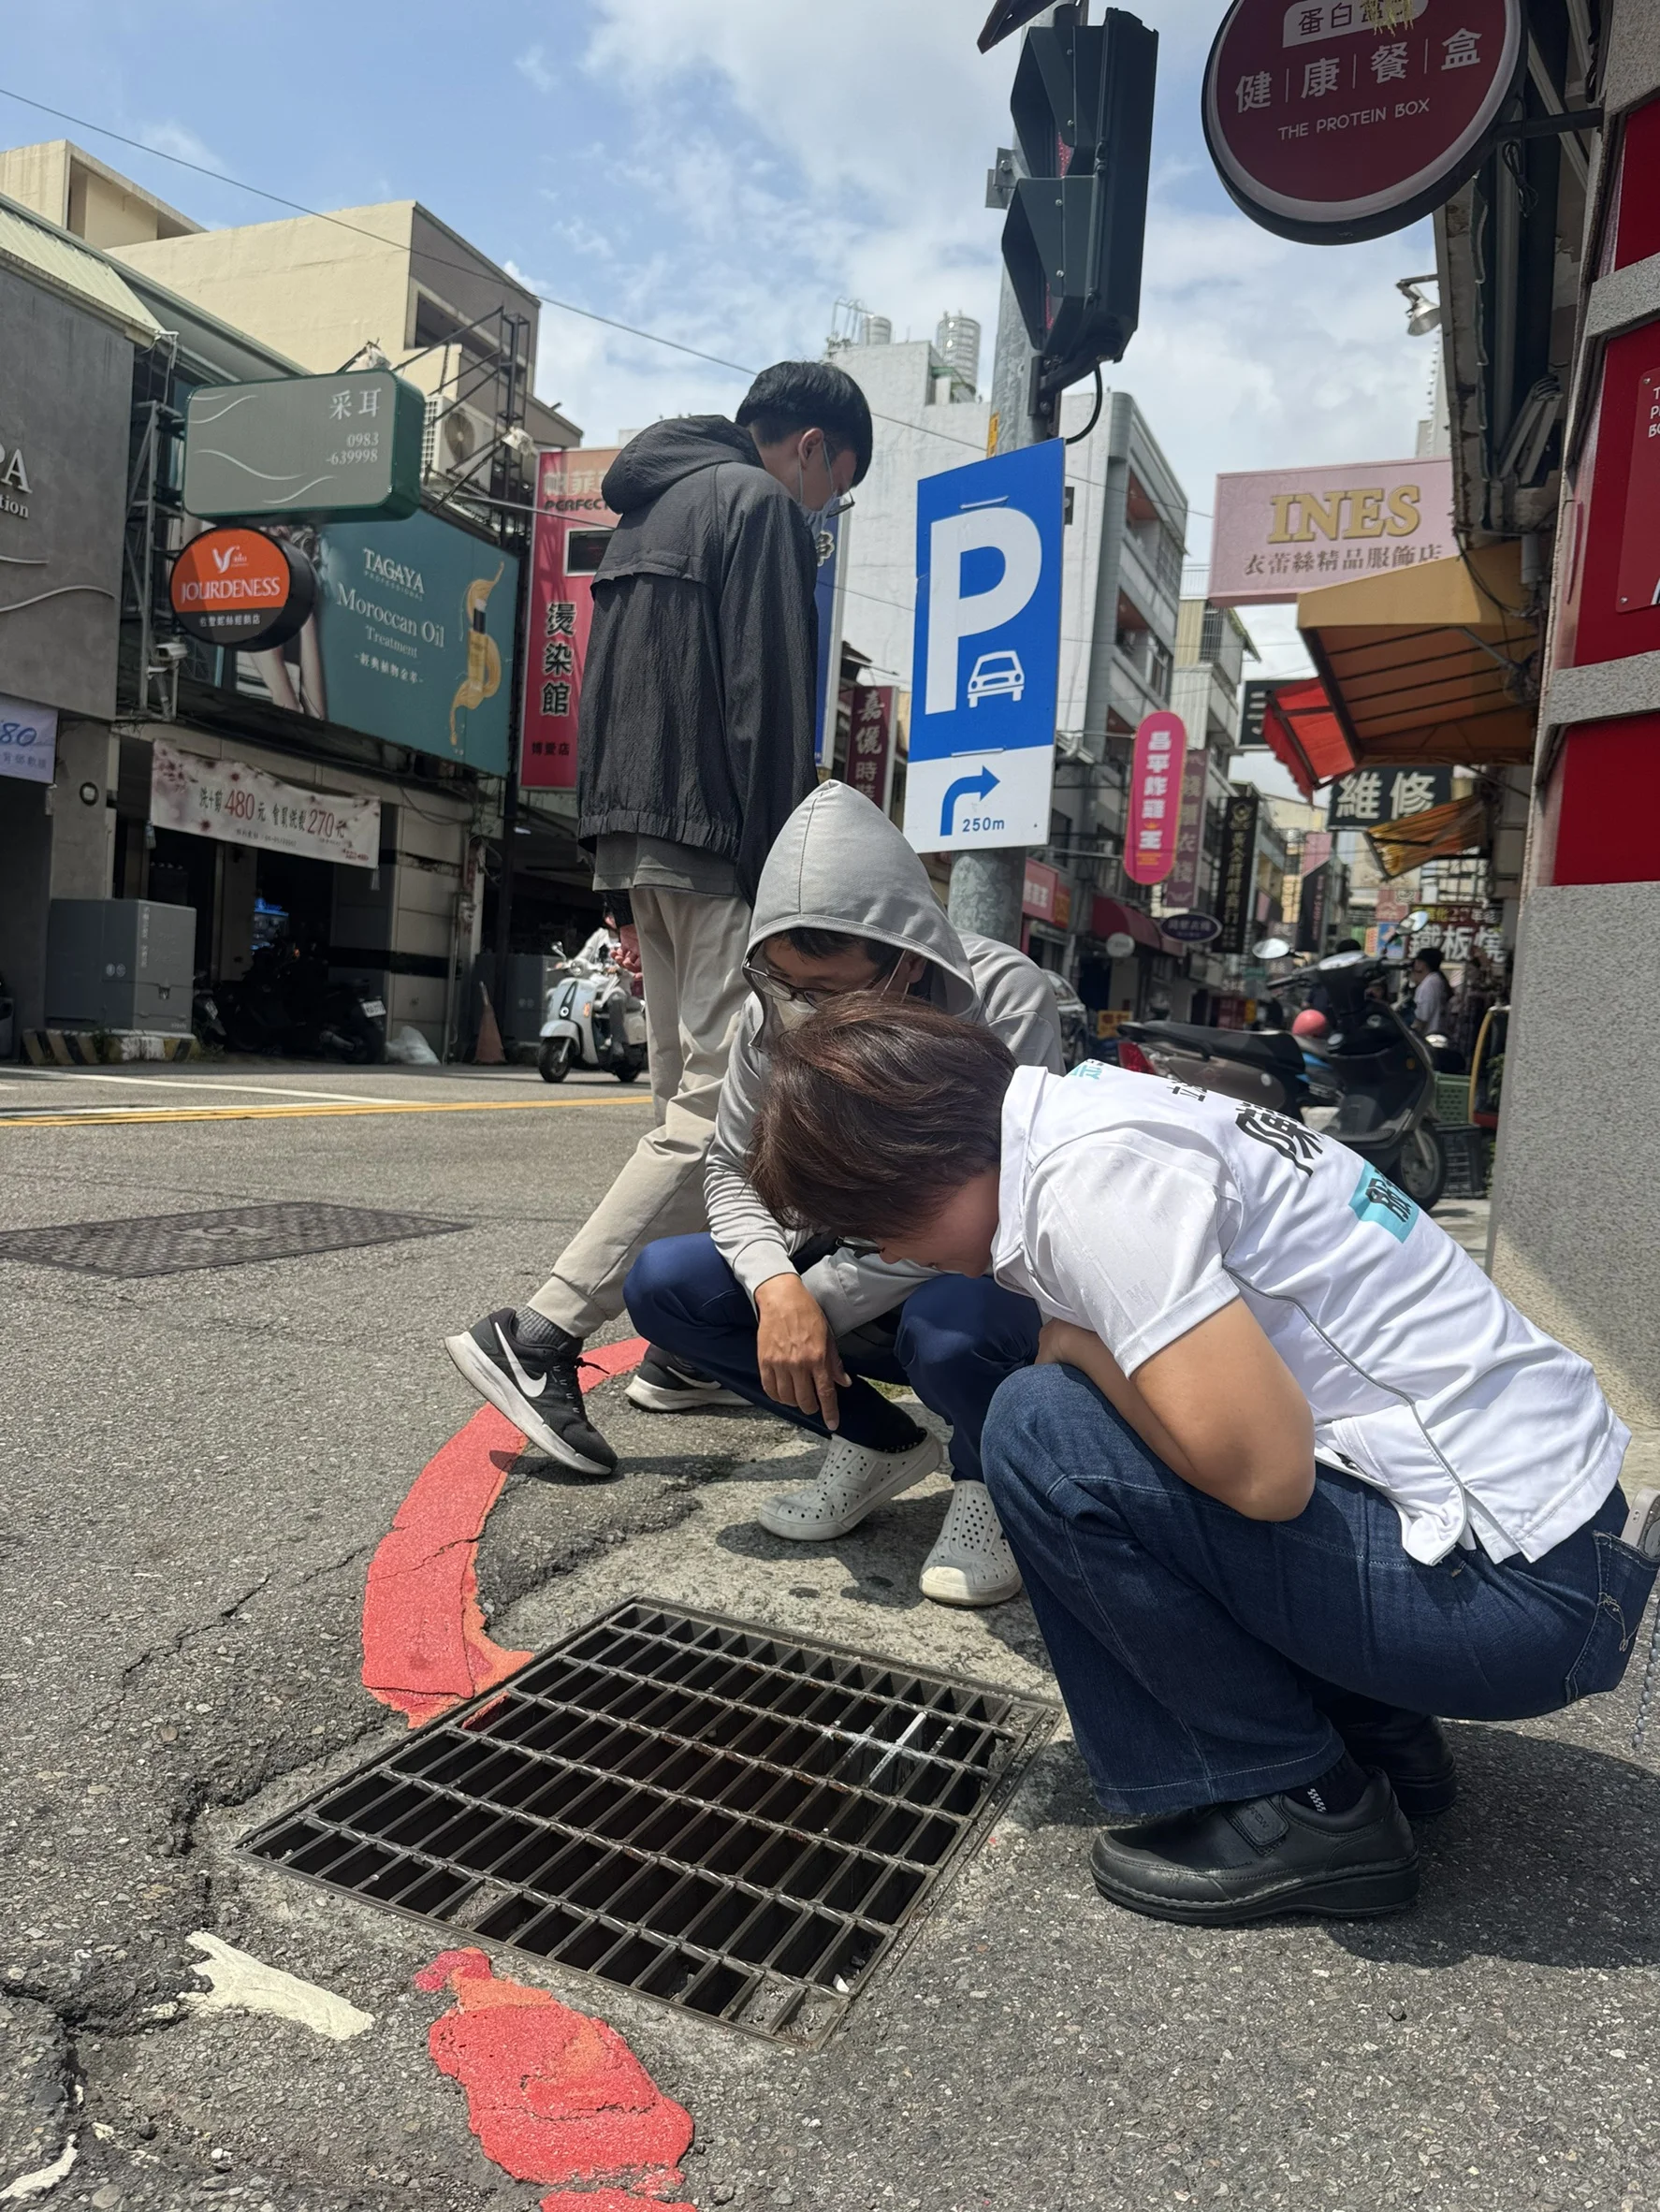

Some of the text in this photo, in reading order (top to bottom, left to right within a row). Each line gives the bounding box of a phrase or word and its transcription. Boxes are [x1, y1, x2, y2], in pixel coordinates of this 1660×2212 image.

[1278, 98, 1431, 140] THE PROTEIN BOX
[329, 387, 382, 420] 采耳
[346, 432, 379, 447] 0983
[1267, 484, 1421, 545] INES
[363, 546, 425, 594] TAGAYA
[1245, 543, 1442, 576] 衣蕾絲精品服飾店
[181, 576, 281, 604] JOURDENESS
[337, 582, 444, 648] Moroccan Oil
[925, 507, 1042, 716] P
[365, 625, 418, 658] Treatment
[540, 602, 577, 717] 燙染館
[1139, 730, 1172, 850] 昌平炸雞王
[1335, 770, 1435, 821] 維修
[962, 817, 1005, 833] 250m
[1408, 924, 1506, 964] 鐵板燒
